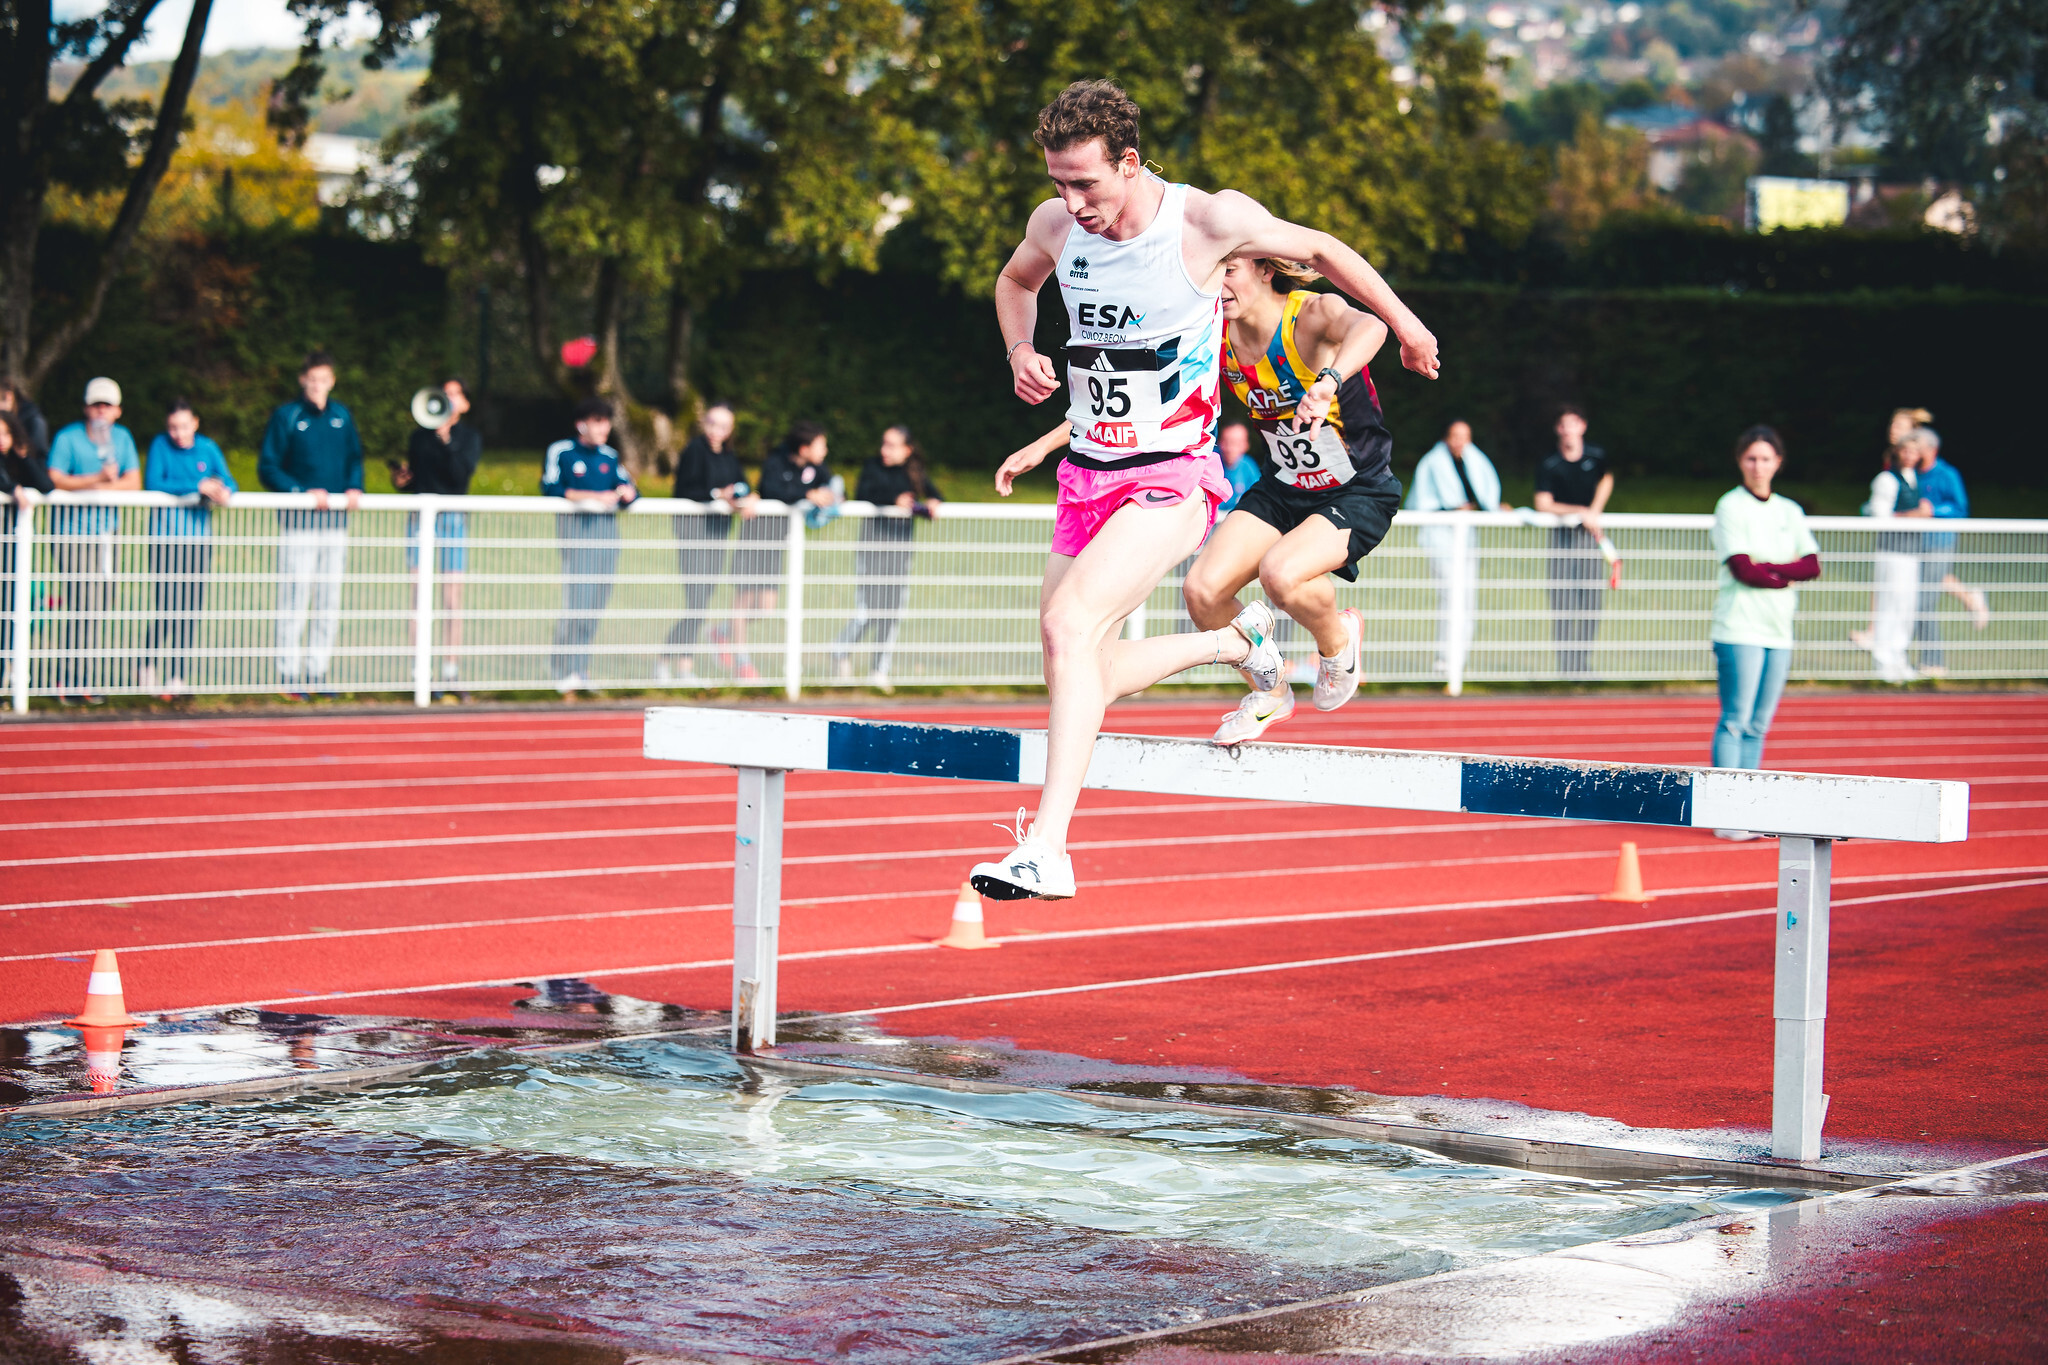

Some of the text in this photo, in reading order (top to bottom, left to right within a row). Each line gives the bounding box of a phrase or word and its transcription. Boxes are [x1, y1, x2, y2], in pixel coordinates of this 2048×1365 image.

[1078, 303, 1142, 330] ESA
[1088, 376, 1131, 418] 95
[1088, 425, 1135, 444] MAIF
[1276, 438, 1321, 470] 93
[1297, 471, 1334, 489] MAIF
